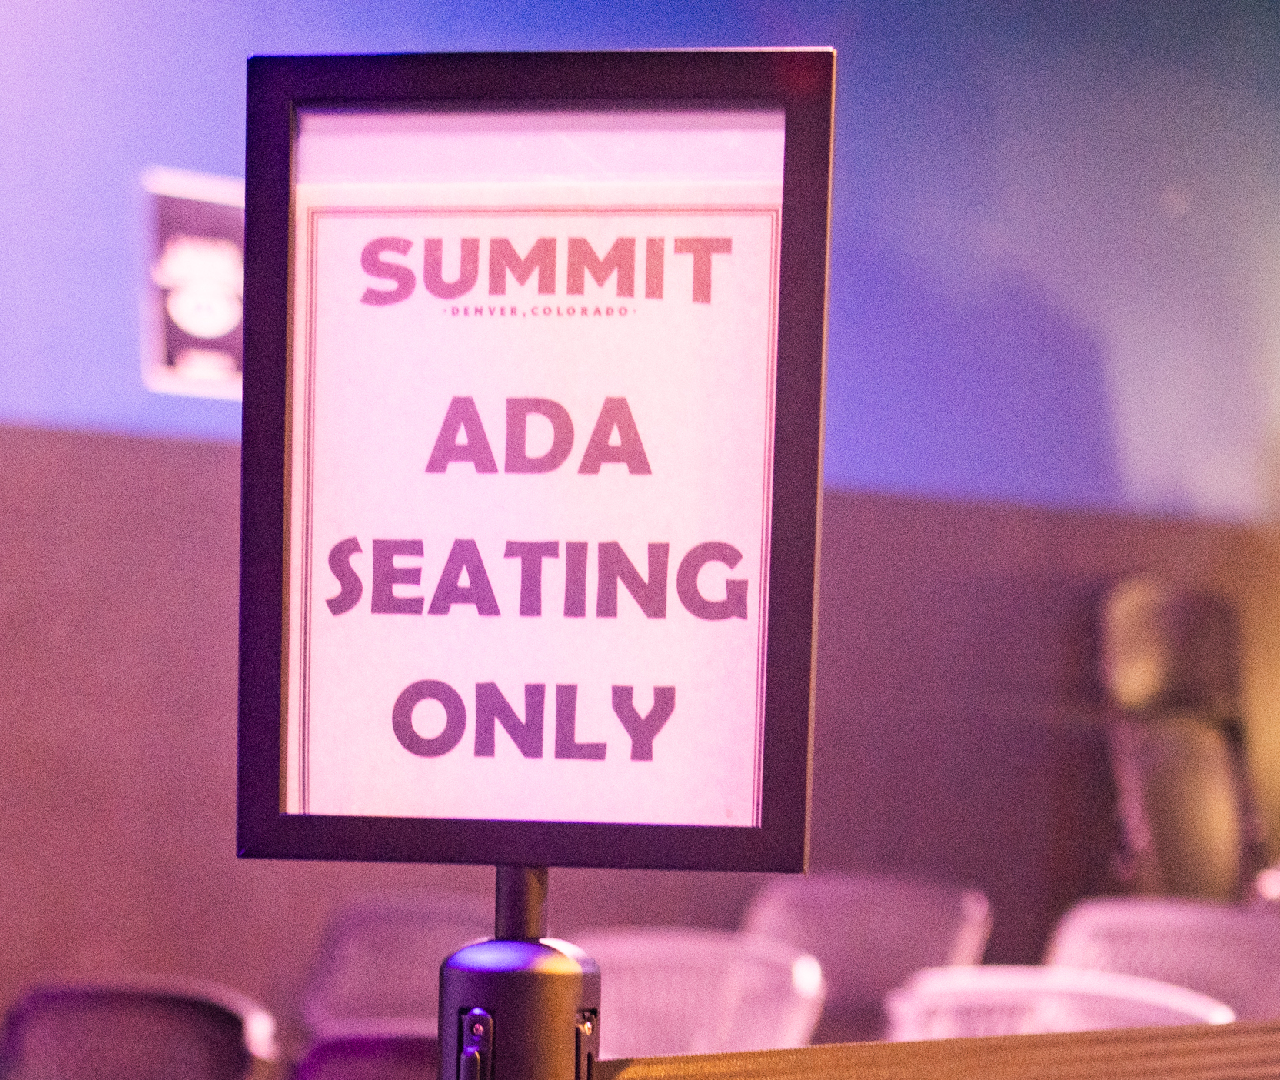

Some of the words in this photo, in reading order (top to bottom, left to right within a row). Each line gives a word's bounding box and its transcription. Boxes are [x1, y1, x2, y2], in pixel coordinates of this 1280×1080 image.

[360, 236, 733, 306] SUMMIT
[425, 397, 651, 475] ADA
[325, 537, 749, 620] SEATING
[391, 680, 676, 761] ONLY
